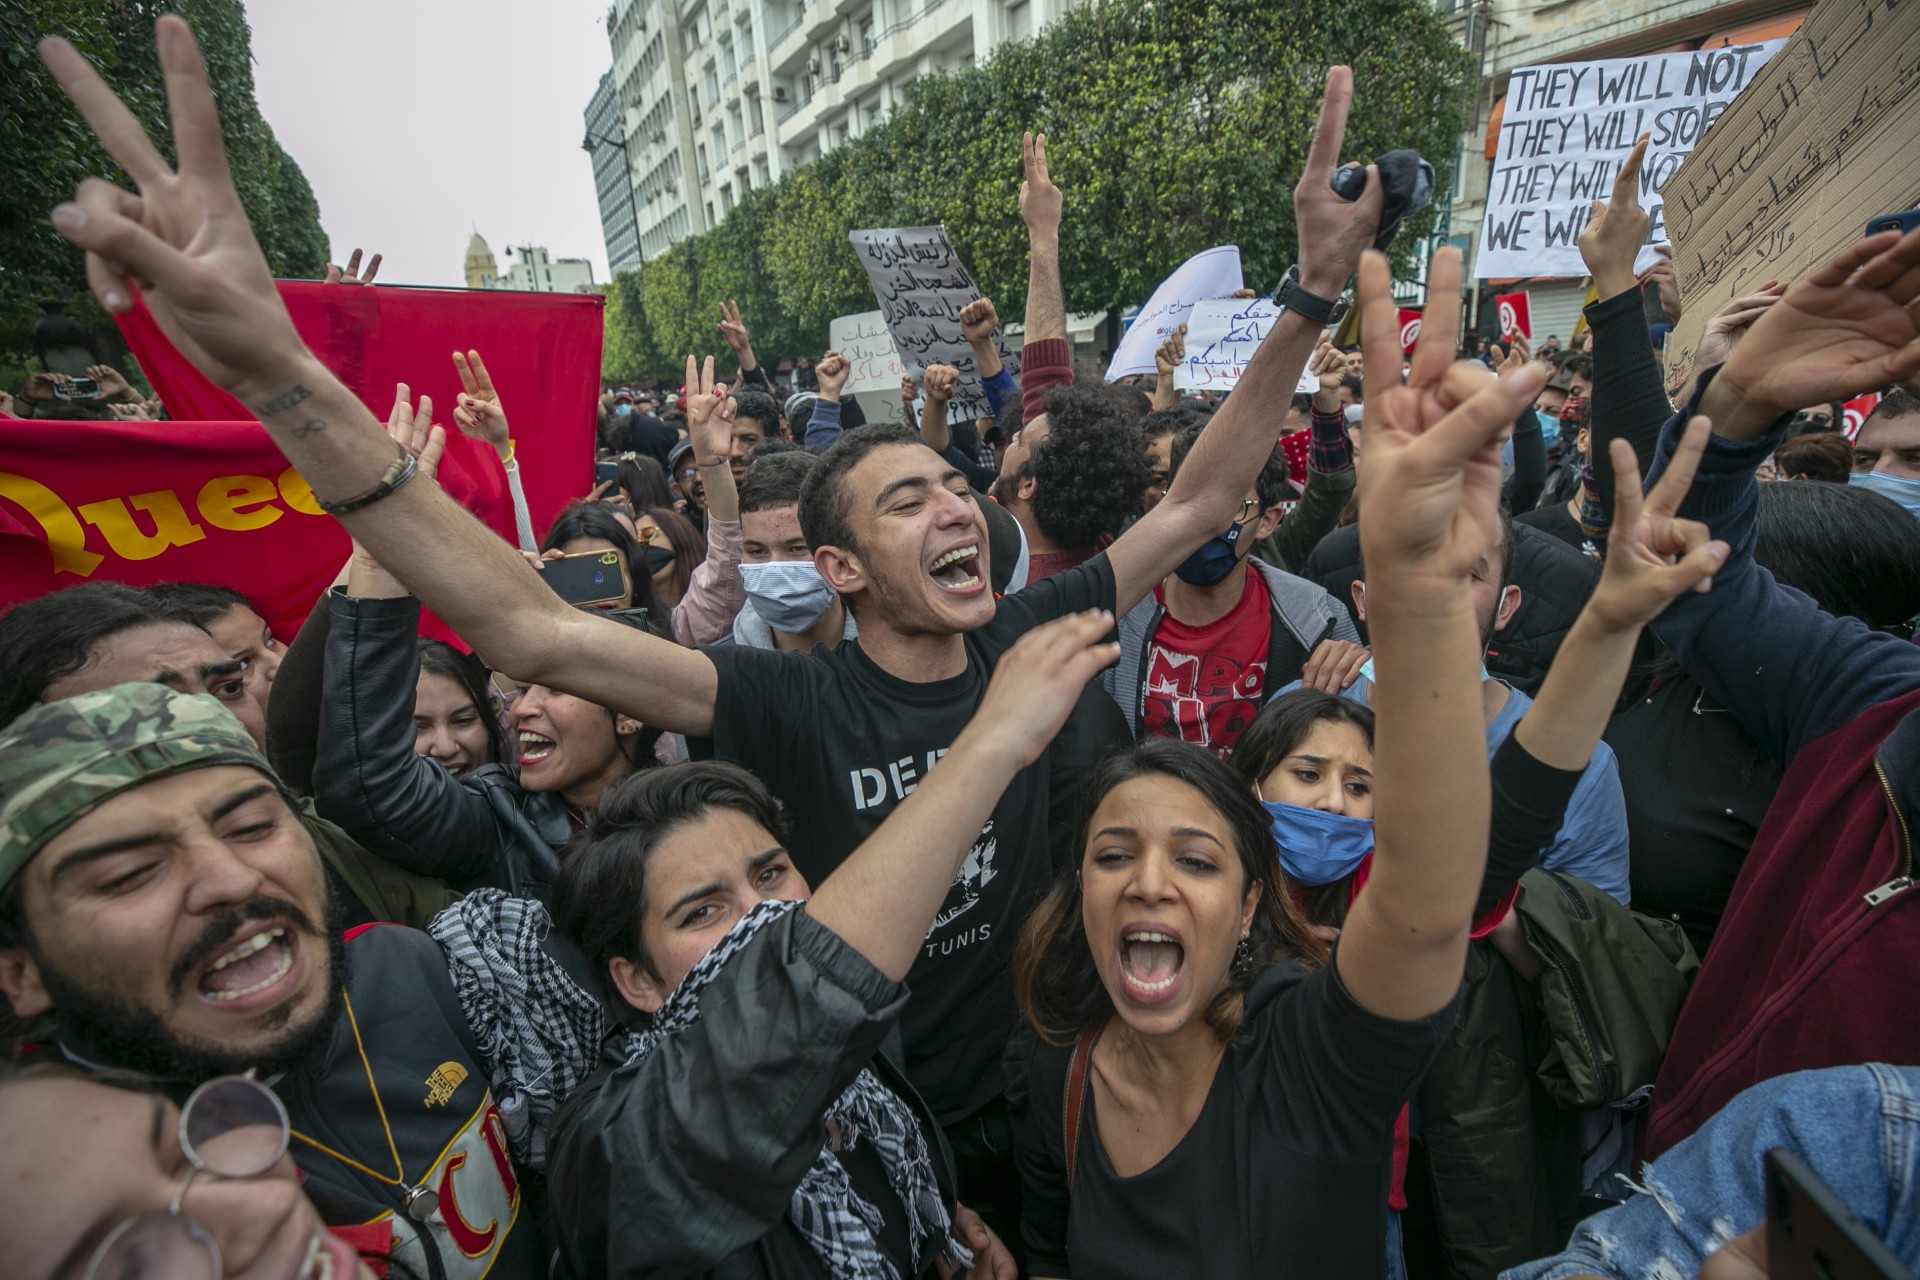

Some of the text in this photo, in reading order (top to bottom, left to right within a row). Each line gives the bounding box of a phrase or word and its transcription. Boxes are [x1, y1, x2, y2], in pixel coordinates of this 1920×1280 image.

[1510, 44, 1764, 112] THEY WILL NOT
[1502, 113, 1576, 160] THEY
[1496, 161, 1571, 205] THEY
[1487, 210, 1535, 251] WE
[926, 923, 992, 958] TUNIS
[423, 1077, 450, 1109] NORTH
[425, 1068, 442, 1088] THE
[439, 1083, 455, 1108] FACE
